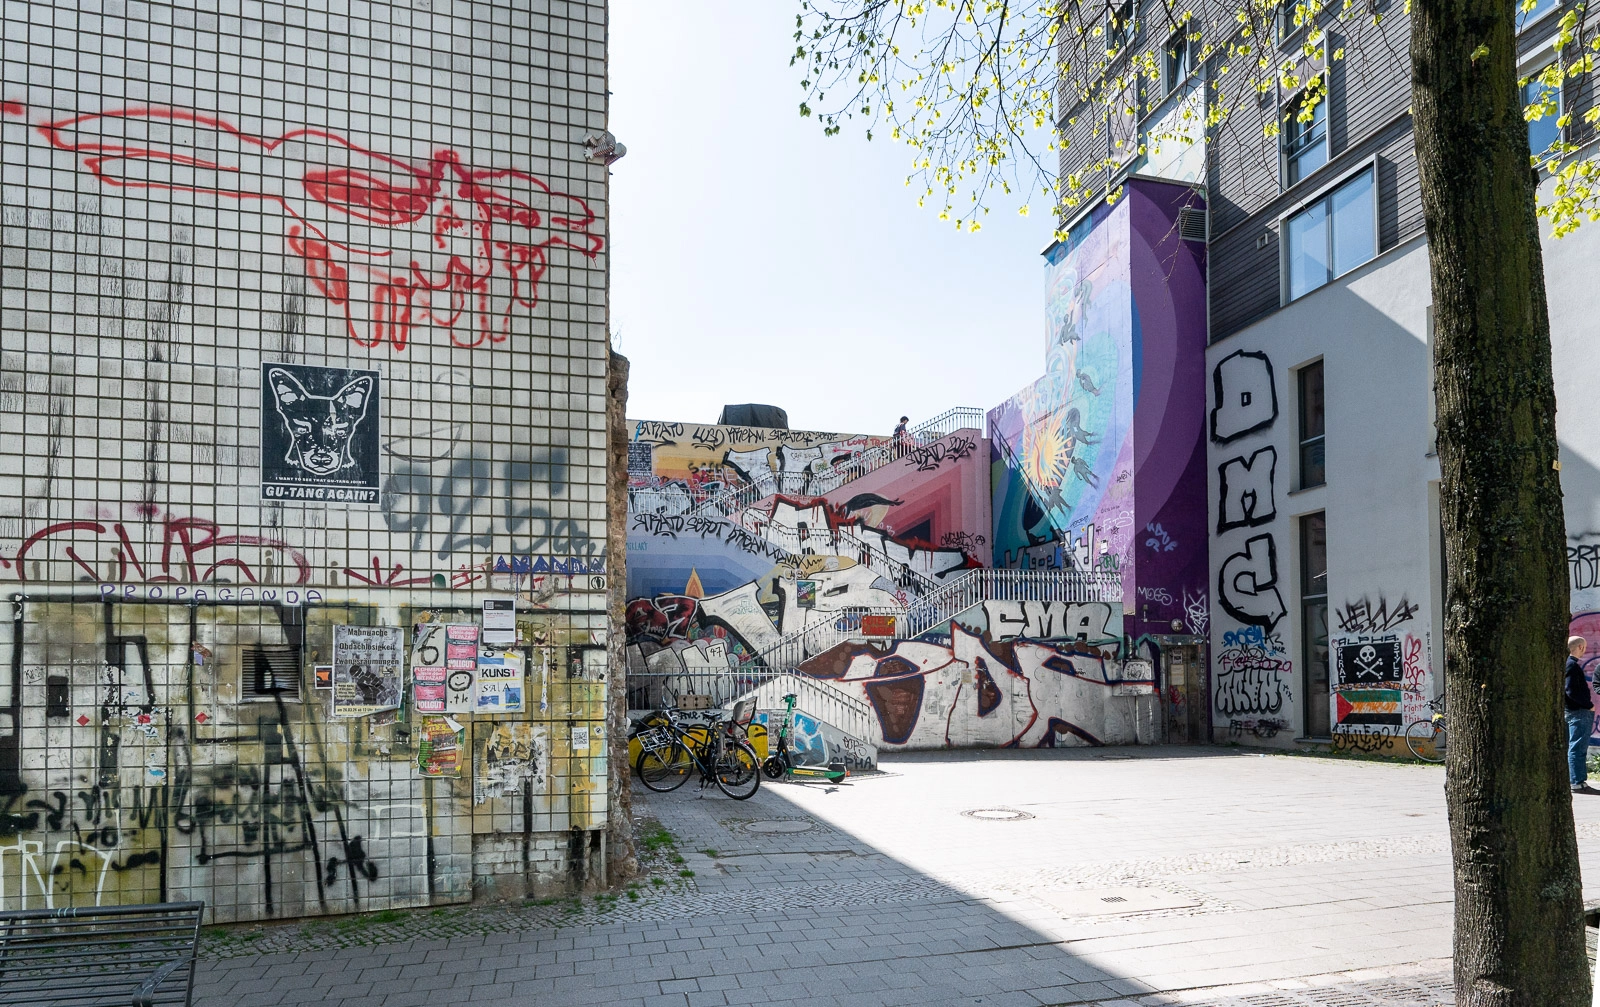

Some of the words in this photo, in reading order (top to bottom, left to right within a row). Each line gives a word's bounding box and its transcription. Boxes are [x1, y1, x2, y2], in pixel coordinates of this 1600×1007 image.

[266, 486, 324, 499] GU-TANG
[327, 488, 376, 501] AGAIN?
[100, 583, 323, 604] PROPAGANDA
[348, 628, 388, 637] Mahnwache
[339, 643, 396, 651] Obdachlosigkeit
[482, 669, 516, 677] KUNST
